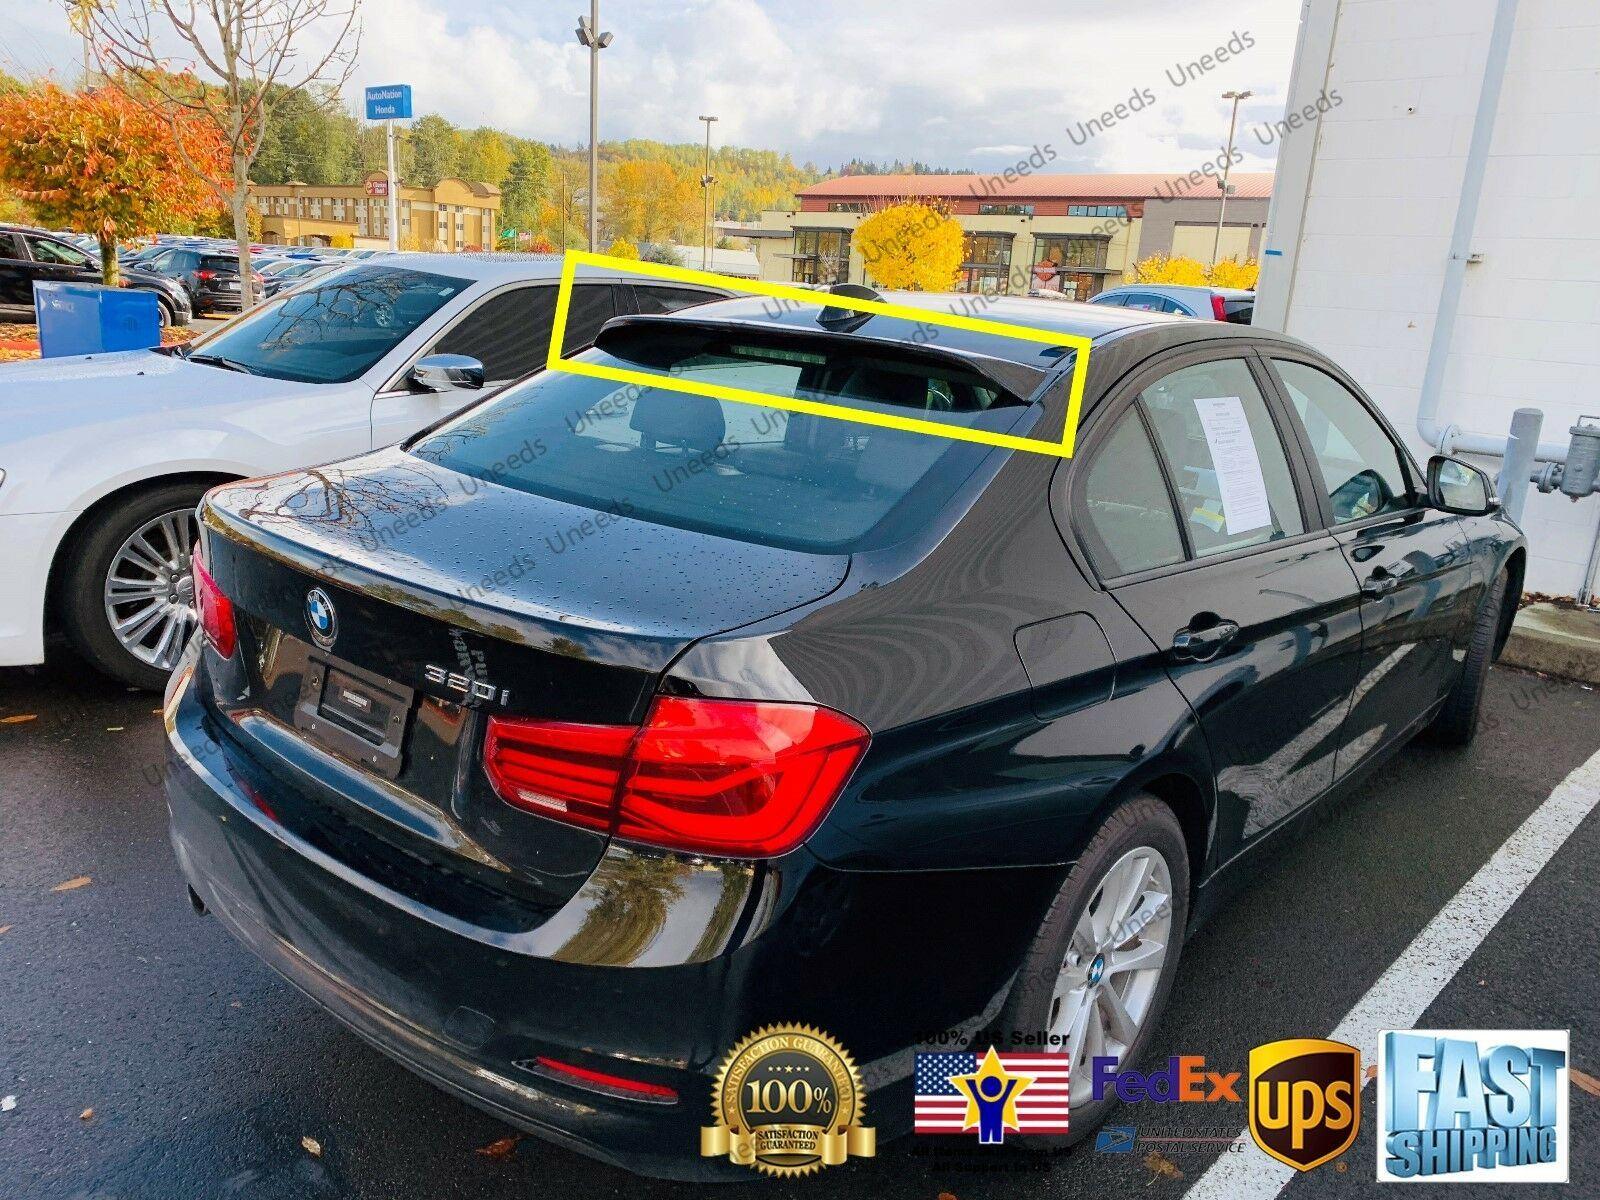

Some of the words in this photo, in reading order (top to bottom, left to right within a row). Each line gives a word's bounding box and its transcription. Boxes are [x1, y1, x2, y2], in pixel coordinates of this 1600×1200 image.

[367, 89, 402, 101] AutoNation
[375, 104, 395, 114] Honda
[424, 664, 509, 706] 320i
